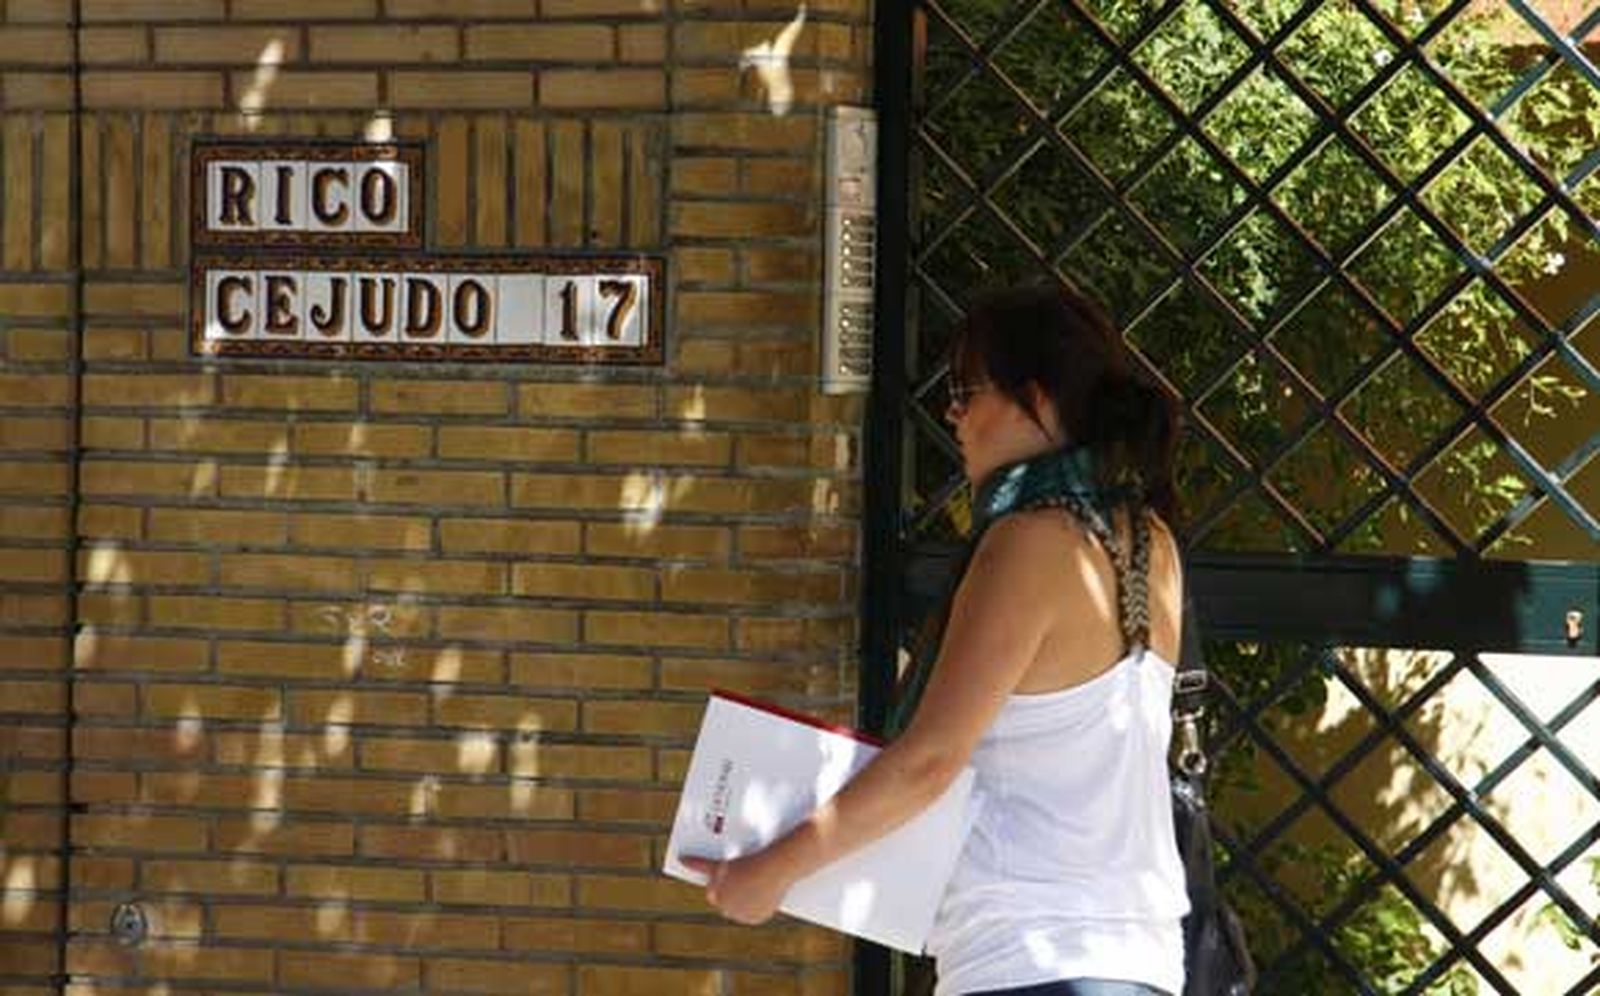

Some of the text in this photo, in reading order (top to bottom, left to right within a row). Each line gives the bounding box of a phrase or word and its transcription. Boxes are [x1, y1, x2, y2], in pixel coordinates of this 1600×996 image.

[220, 166, 398, 227] RICO
[216, 275, 638, 342] CEJUDO 17
